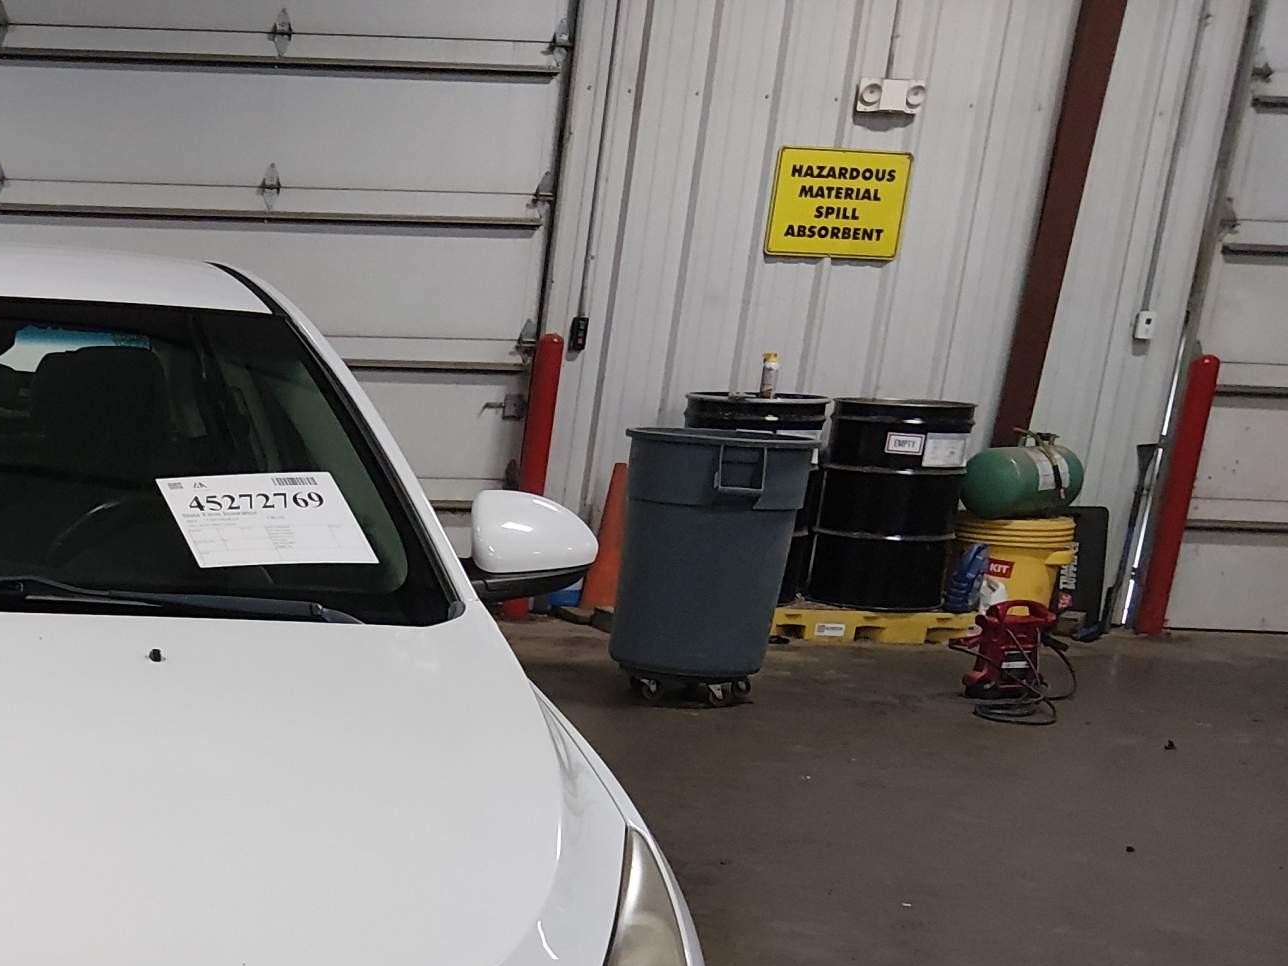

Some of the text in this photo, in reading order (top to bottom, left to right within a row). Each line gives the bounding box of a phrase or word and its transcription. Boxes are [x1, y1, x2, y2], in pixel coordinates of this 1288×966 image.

[791, 164, 896, 182] HAZARDOUS
[798, 185, 881, 201] MATERIAL
[814, 205, 859, 220] SPILL
[784, 224, 884, 241] ABSORBENT
[894, 438, 916, 449] EMPTY
[189, 491, 324, 511] 45272769
[989, 562, 1010, 573] KIT
